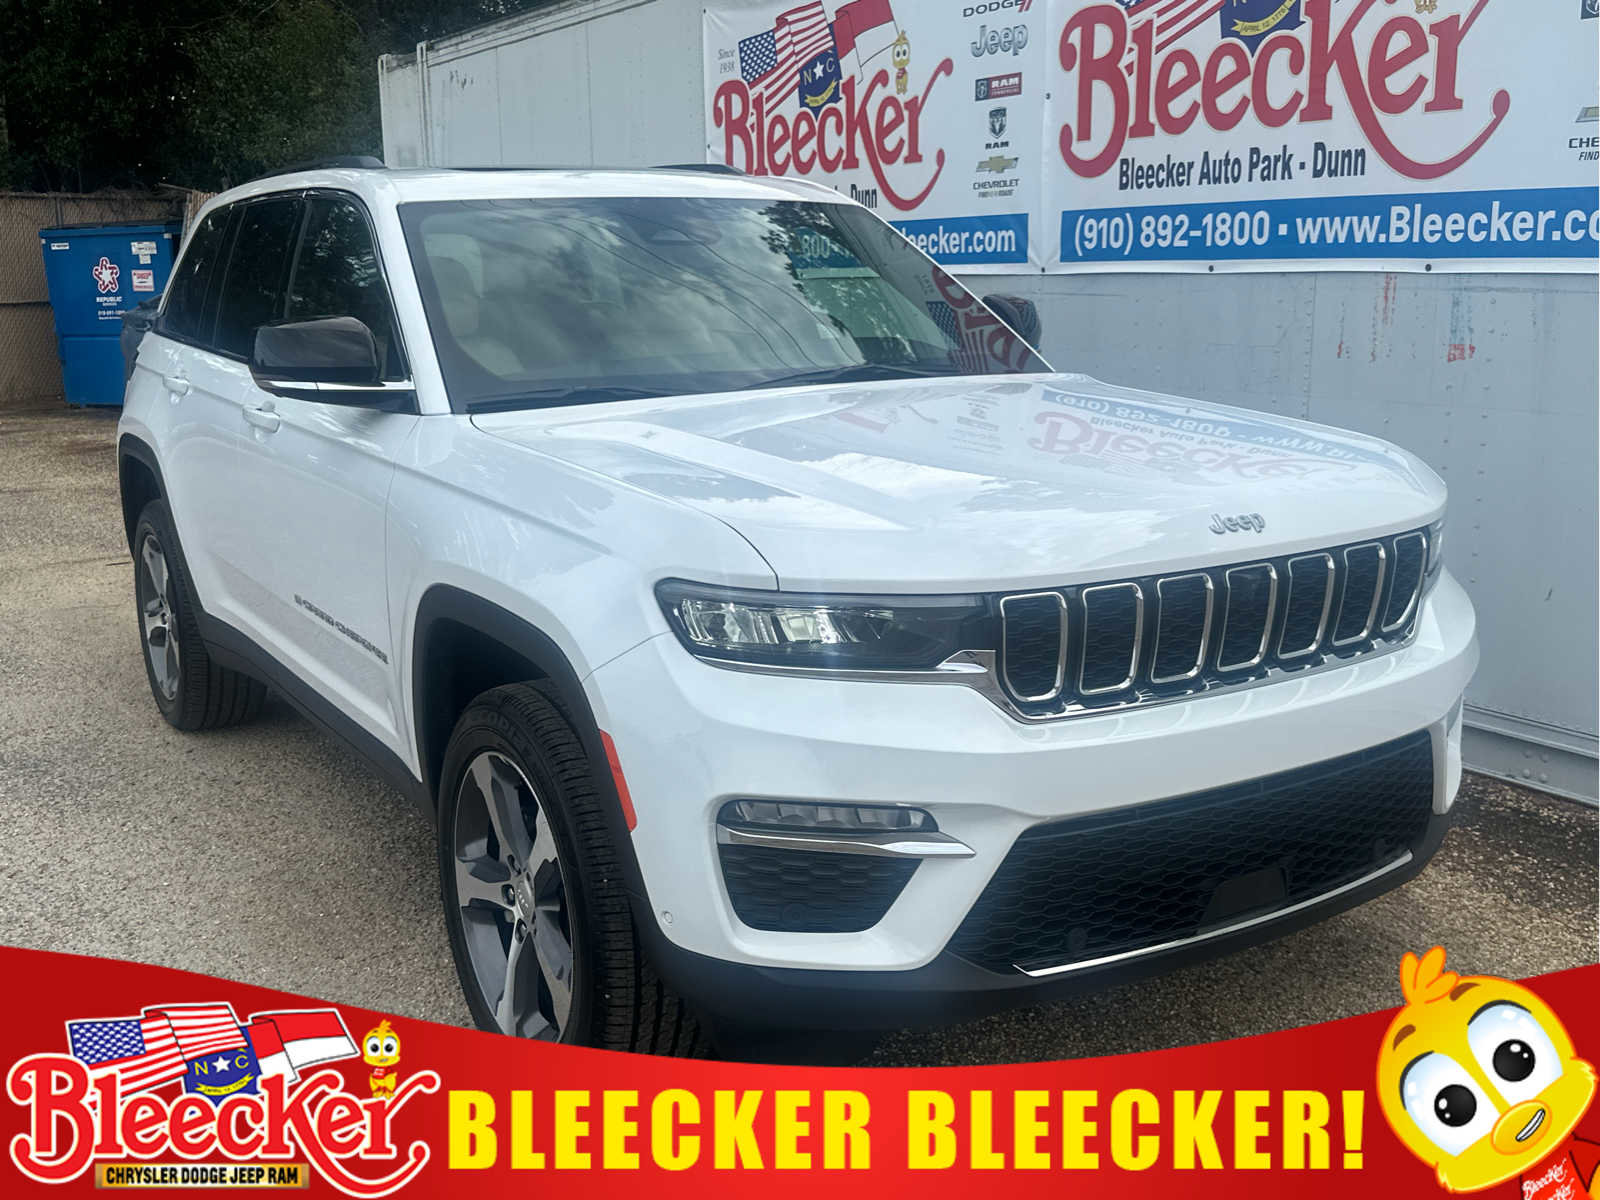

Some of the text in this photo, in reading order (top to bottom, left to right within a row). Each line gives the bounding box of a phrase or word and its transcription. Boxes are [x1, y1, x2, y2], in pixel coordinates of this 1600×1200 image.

[963, 0, 1021, 17] DODGE
[971, 24, 1028, 57] Jeep
[991, 77, 1019, 88] RAM
[1058, 0, 1511, 181] Bleecker
[713, 57, 954, 212] Bleecker
[985, 141, 1010, 150] RAM
[1118, 141, 1366, 191] Bleecker Auto Park Dunn
[973, 179, 1020, 190] CHEVROLET
[1075, 212, 1134, 257] (910)
[1140, 210, 1270, 248] 892-1800
[1208, 512, 1266, 535] Jeep
